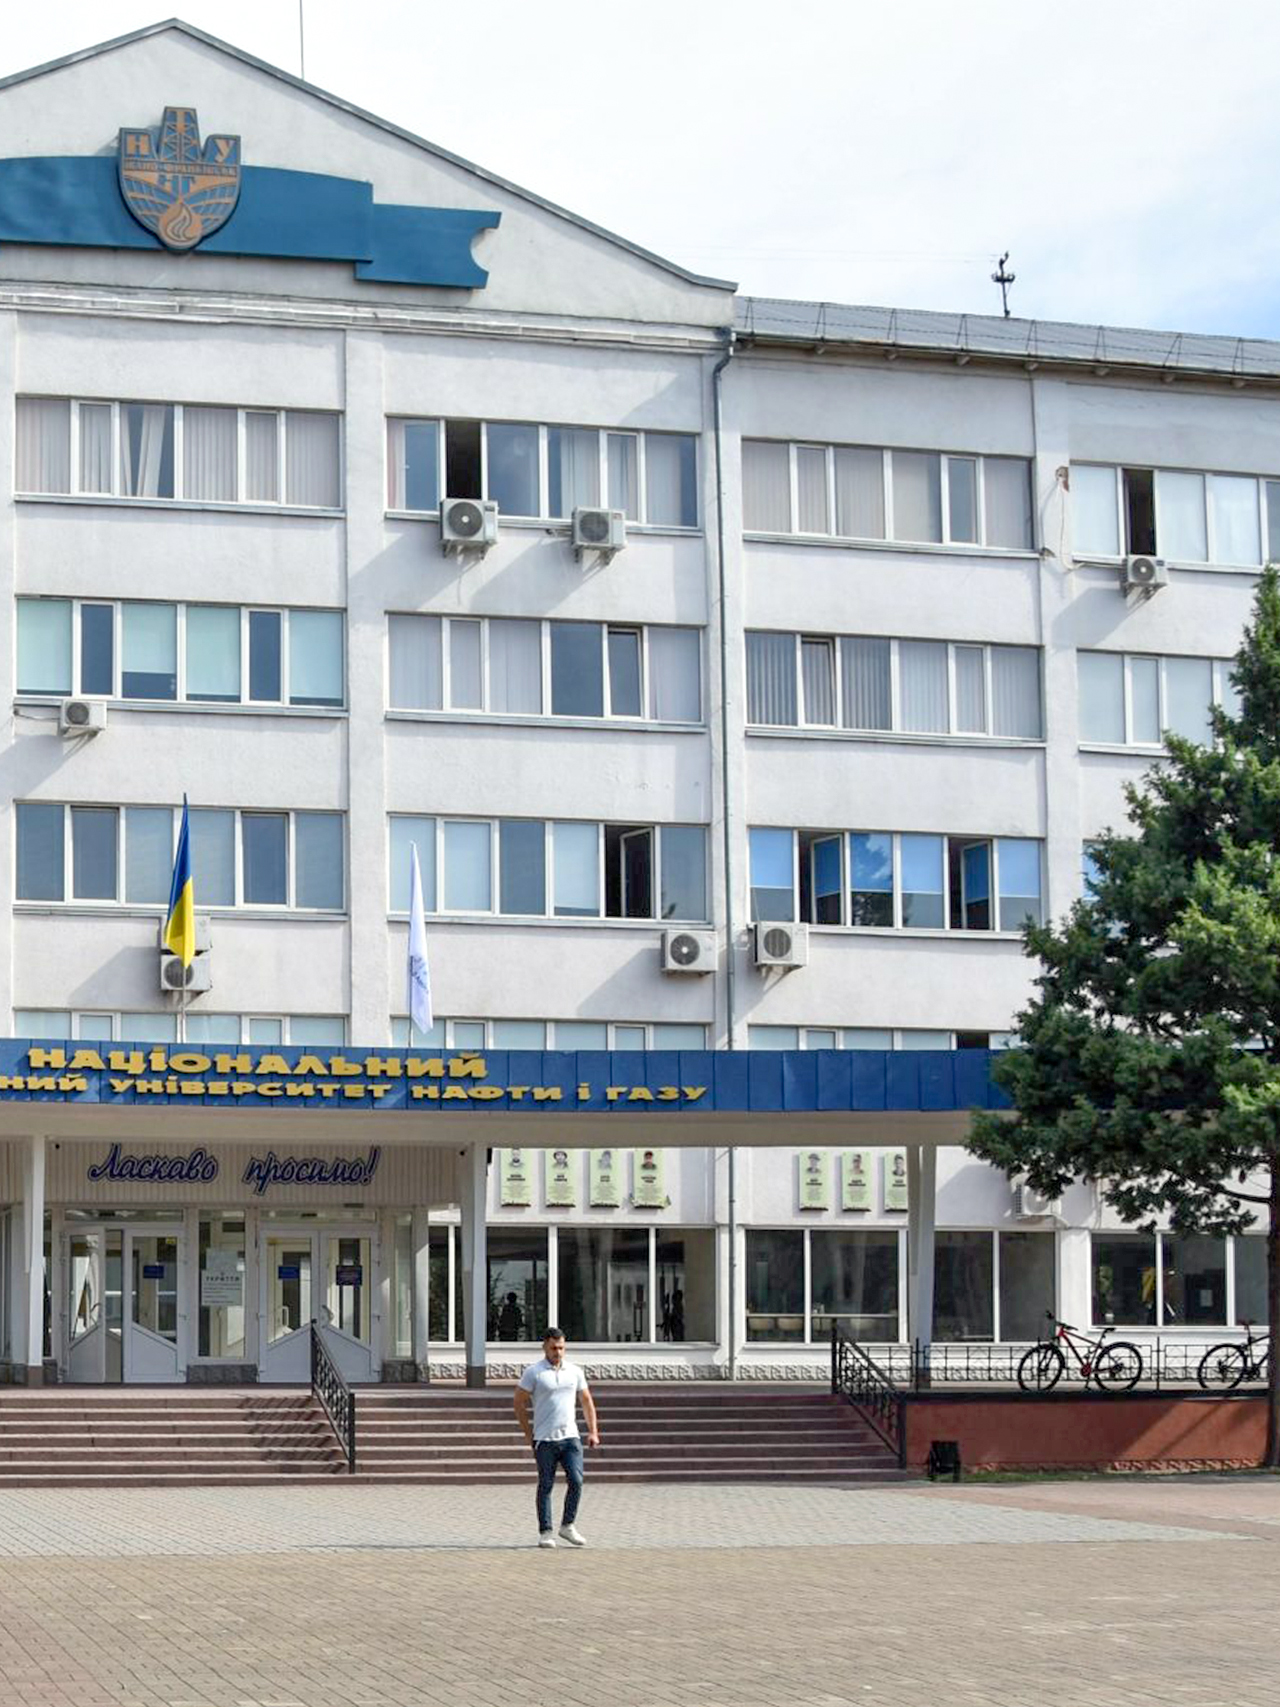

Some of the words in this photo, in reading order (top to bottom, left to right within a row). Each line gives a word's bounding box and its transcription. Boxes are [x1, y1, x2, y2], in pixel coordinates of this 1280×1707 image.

[411, 1085, 563, 1100] НАФТИ
[605, 1086, 707, 1100] ГАЗУ
[88, 1142, 219, 1184] Ласкаво
[242, 1145, 381, 1196] просимо!
